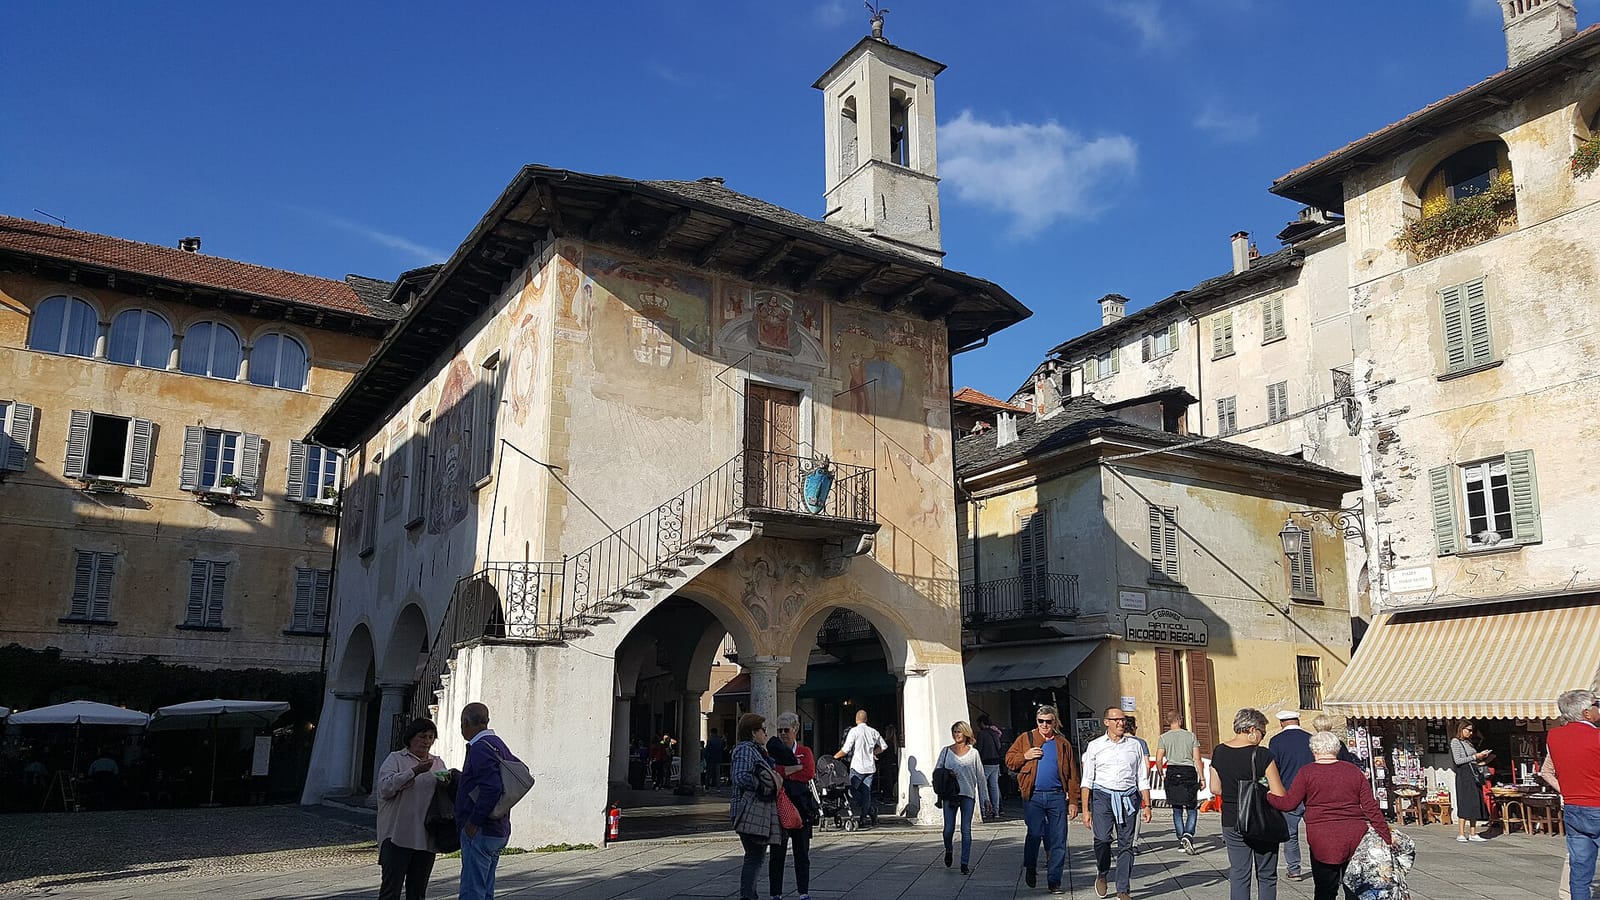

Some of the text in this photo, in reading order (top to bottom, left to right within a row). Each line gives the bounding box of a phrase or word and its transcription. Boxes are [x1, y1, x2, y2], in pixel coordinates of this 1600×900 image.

[1148, 622, 1189, 630] ARTICOLI
[1128, 629, 1206, 643] RICORDO REGALO
